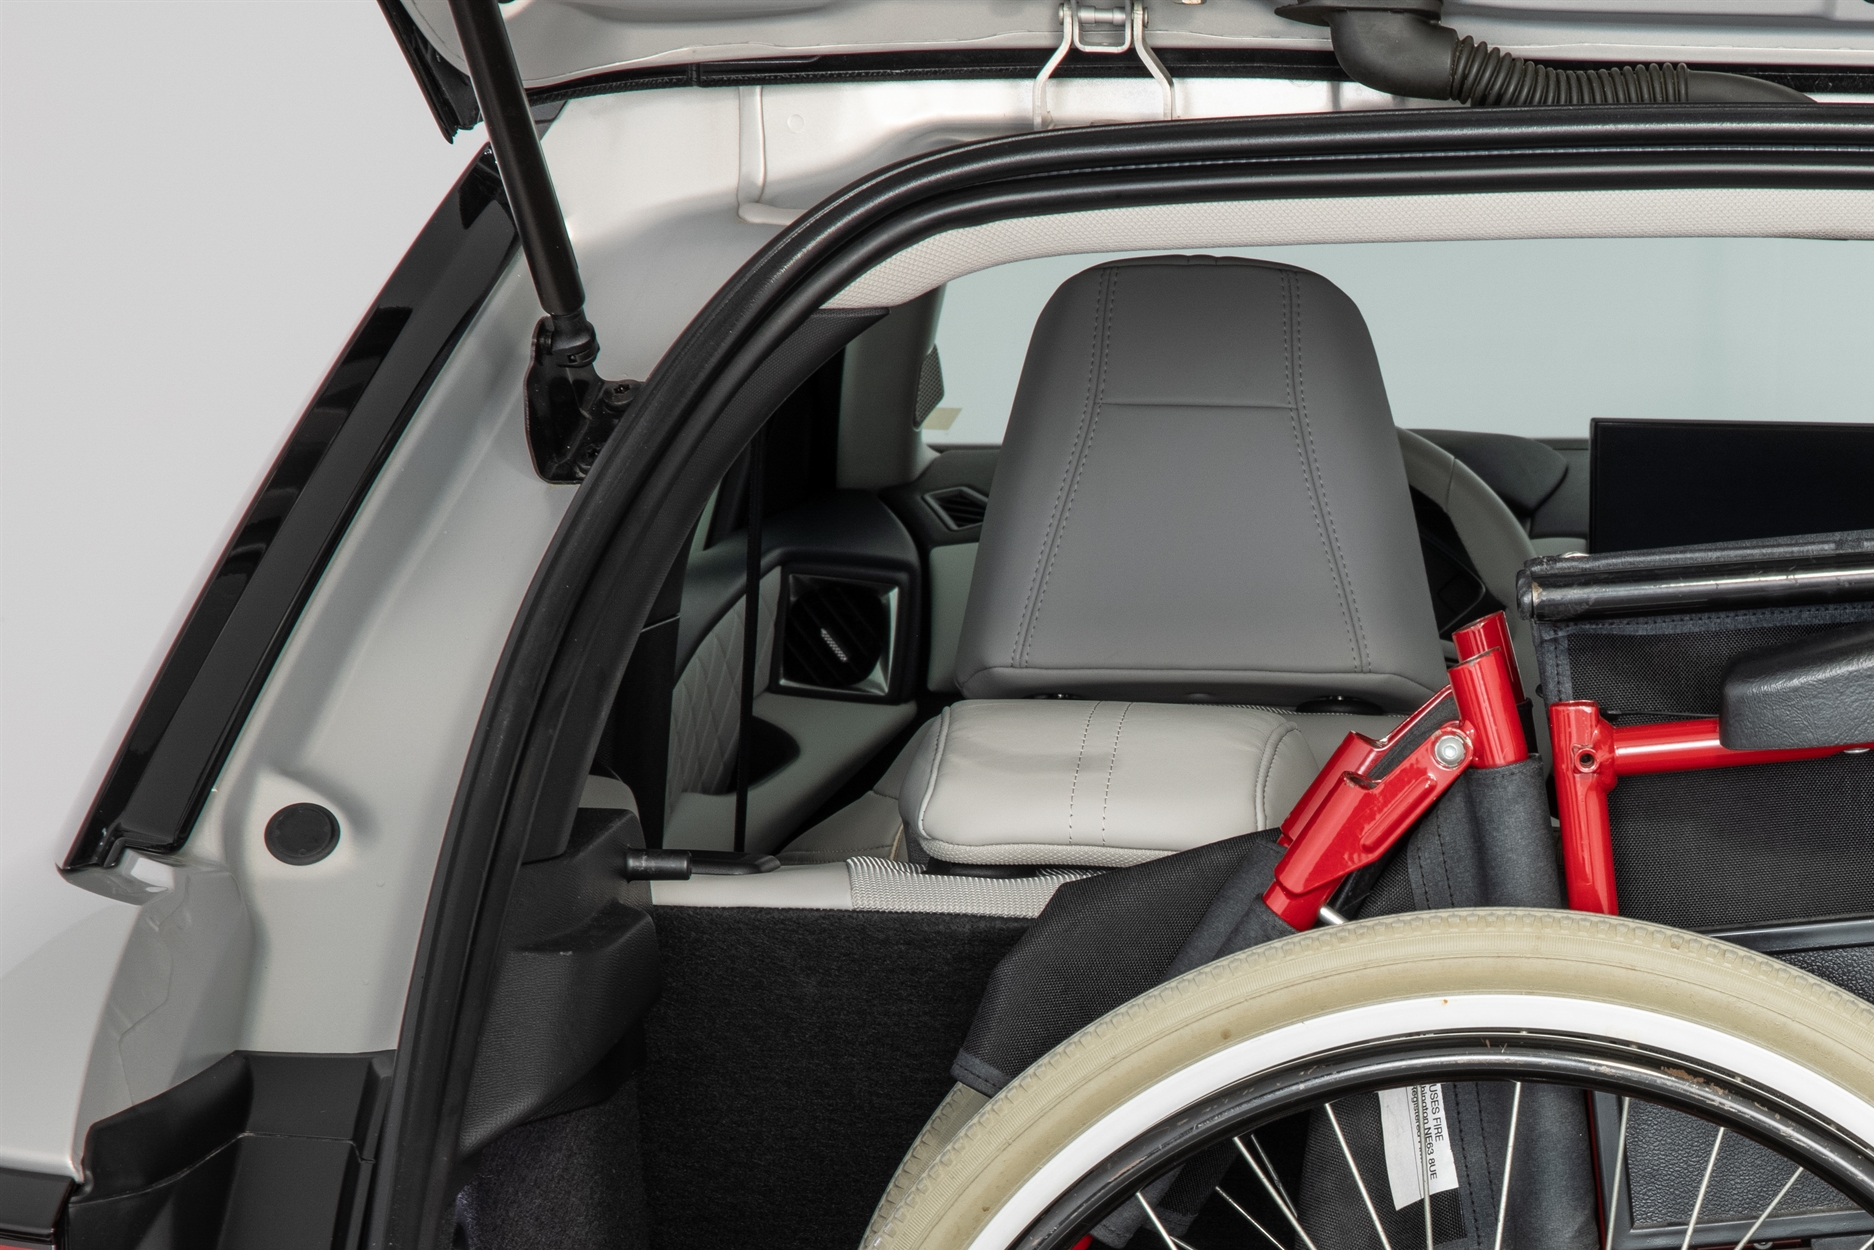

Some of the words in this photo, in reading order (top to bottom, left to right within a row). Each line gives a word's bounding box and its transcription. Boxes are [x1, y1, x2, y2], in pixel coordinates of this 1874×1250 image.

[1428, 1083, 1440, 1115] USES
[1433, 1117, 1444, 1142] FIRE
[1428, 1158, 1438, 1180] 8UE
